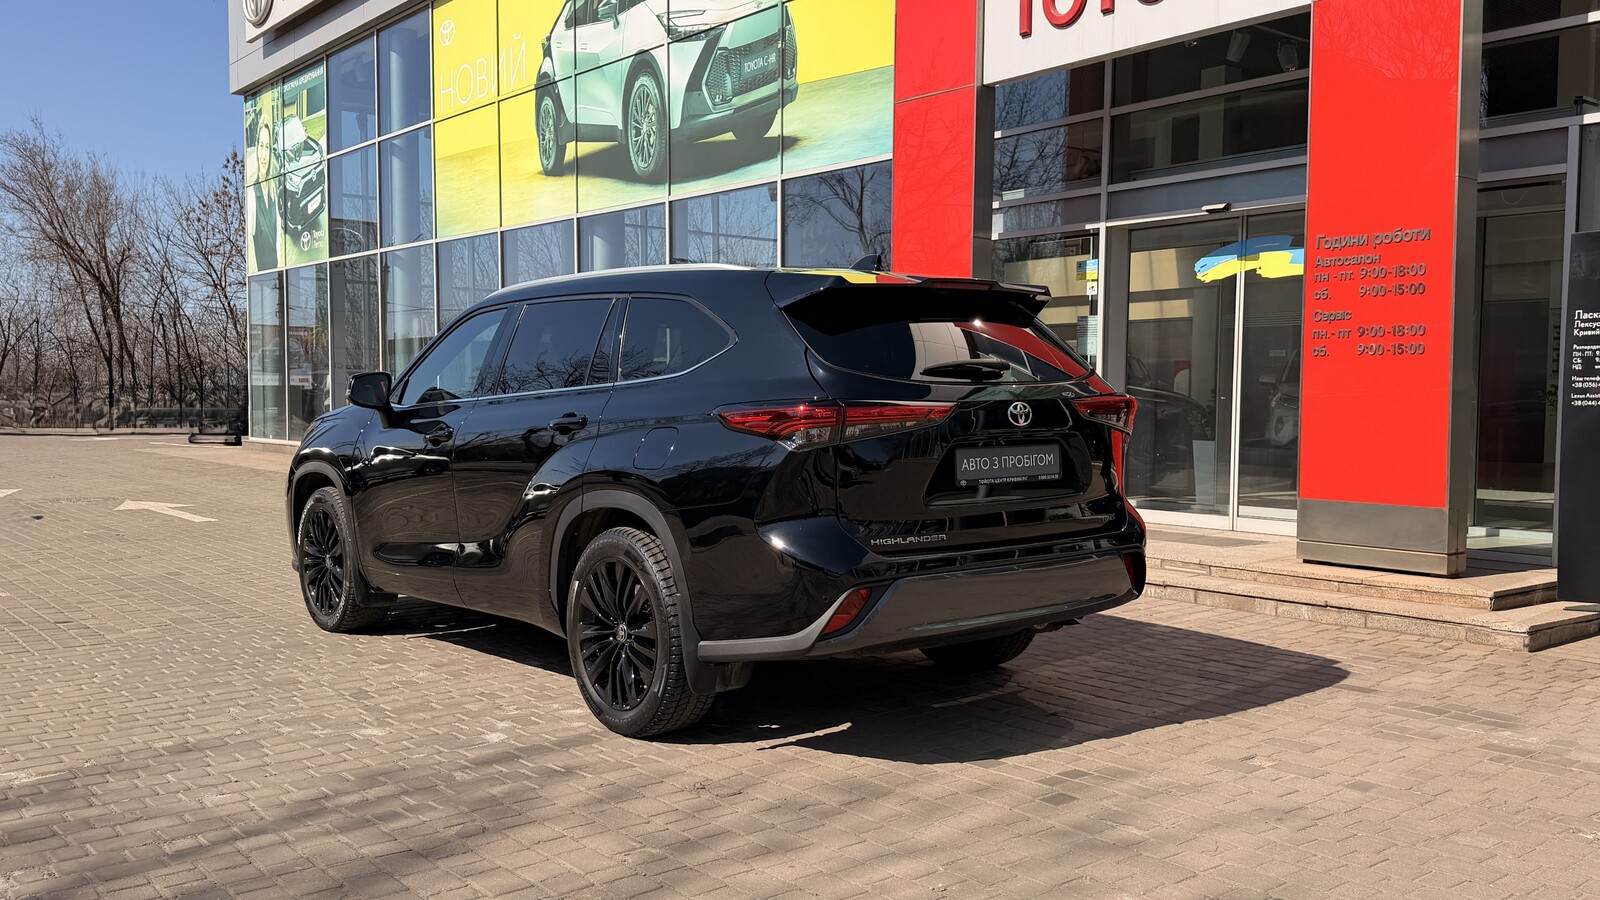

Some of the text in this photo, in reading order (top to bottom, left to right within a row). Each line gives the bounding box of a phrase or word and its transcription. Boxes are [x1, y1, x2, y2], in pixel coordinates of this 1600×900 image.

[744, 52, 777, 73] TOYOTA C-HR
[440, 31, 527, 112] НОВИЙ
[1315, 227, 1431, 251] Години роботи
[1315, 254, 1381, 268] Автосалон
[1359, 263, 1427, 280] 9:00-18:00
[1313, 282, 1426, 301] сб. 9:00-15:00
[1313, 309, 1352, 324] Сервіс
[1357, 324, 1427, 338] 9:00-18:00
[1312, 342, 1426, 357] сб. 9:00-15:00
[961, 457, 990, 471] АВТО
[1001, 453, 1054, 468] ПРОБІГОМ
[870, 534, 947, 546] HIGHLANDER
